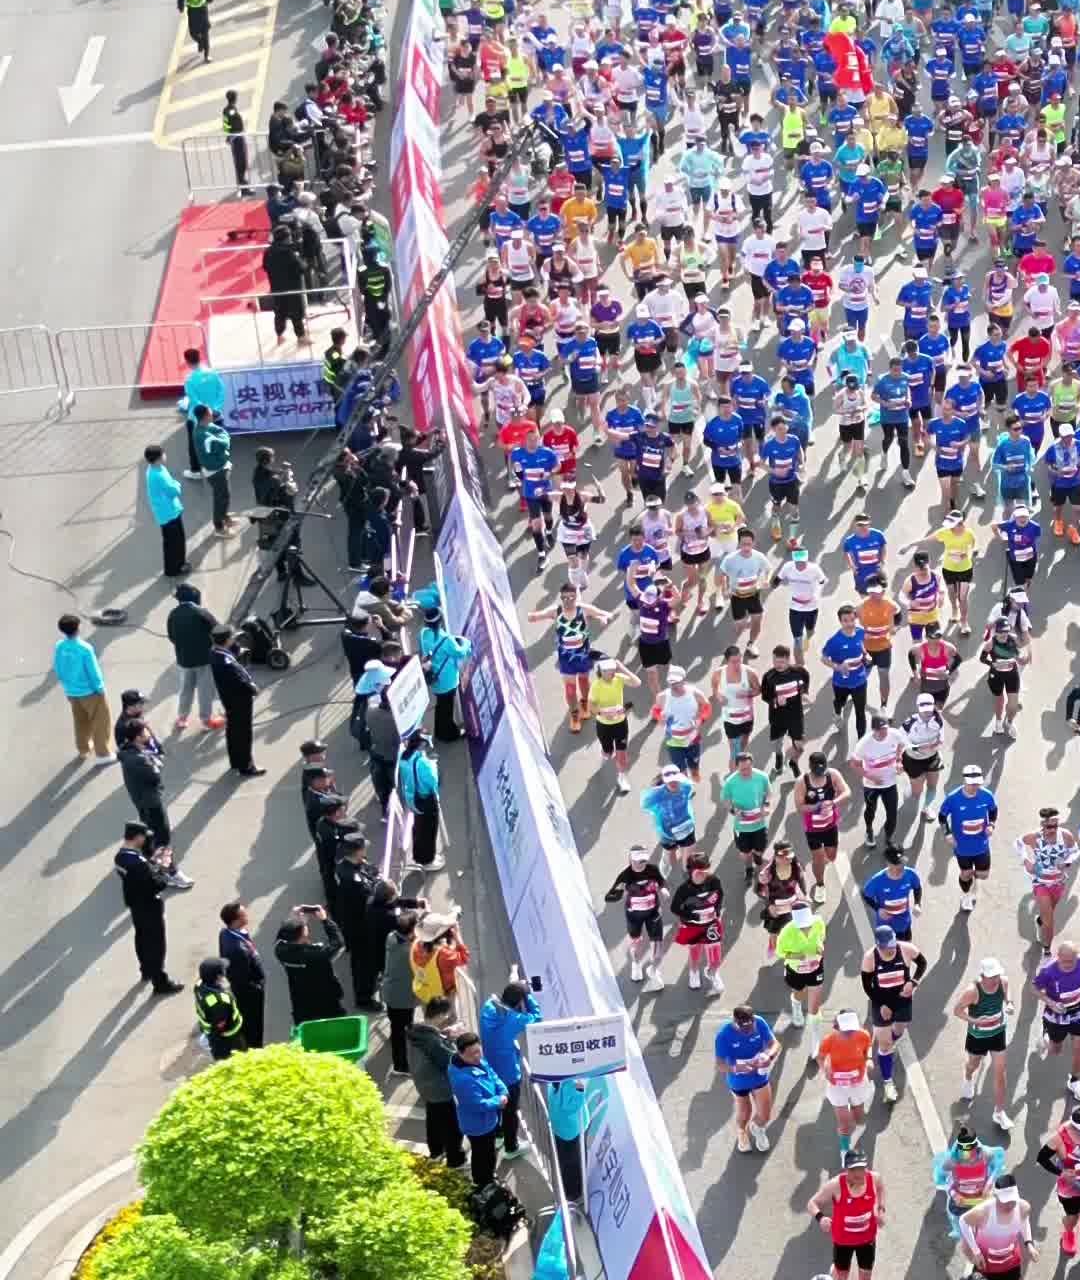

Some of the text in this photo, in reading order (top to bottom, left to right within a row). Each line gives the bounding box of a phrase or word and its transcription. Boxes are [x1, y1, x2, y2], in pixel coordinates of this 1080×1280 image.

[538, 1035, 616, 1056] 垃圾回收箱
